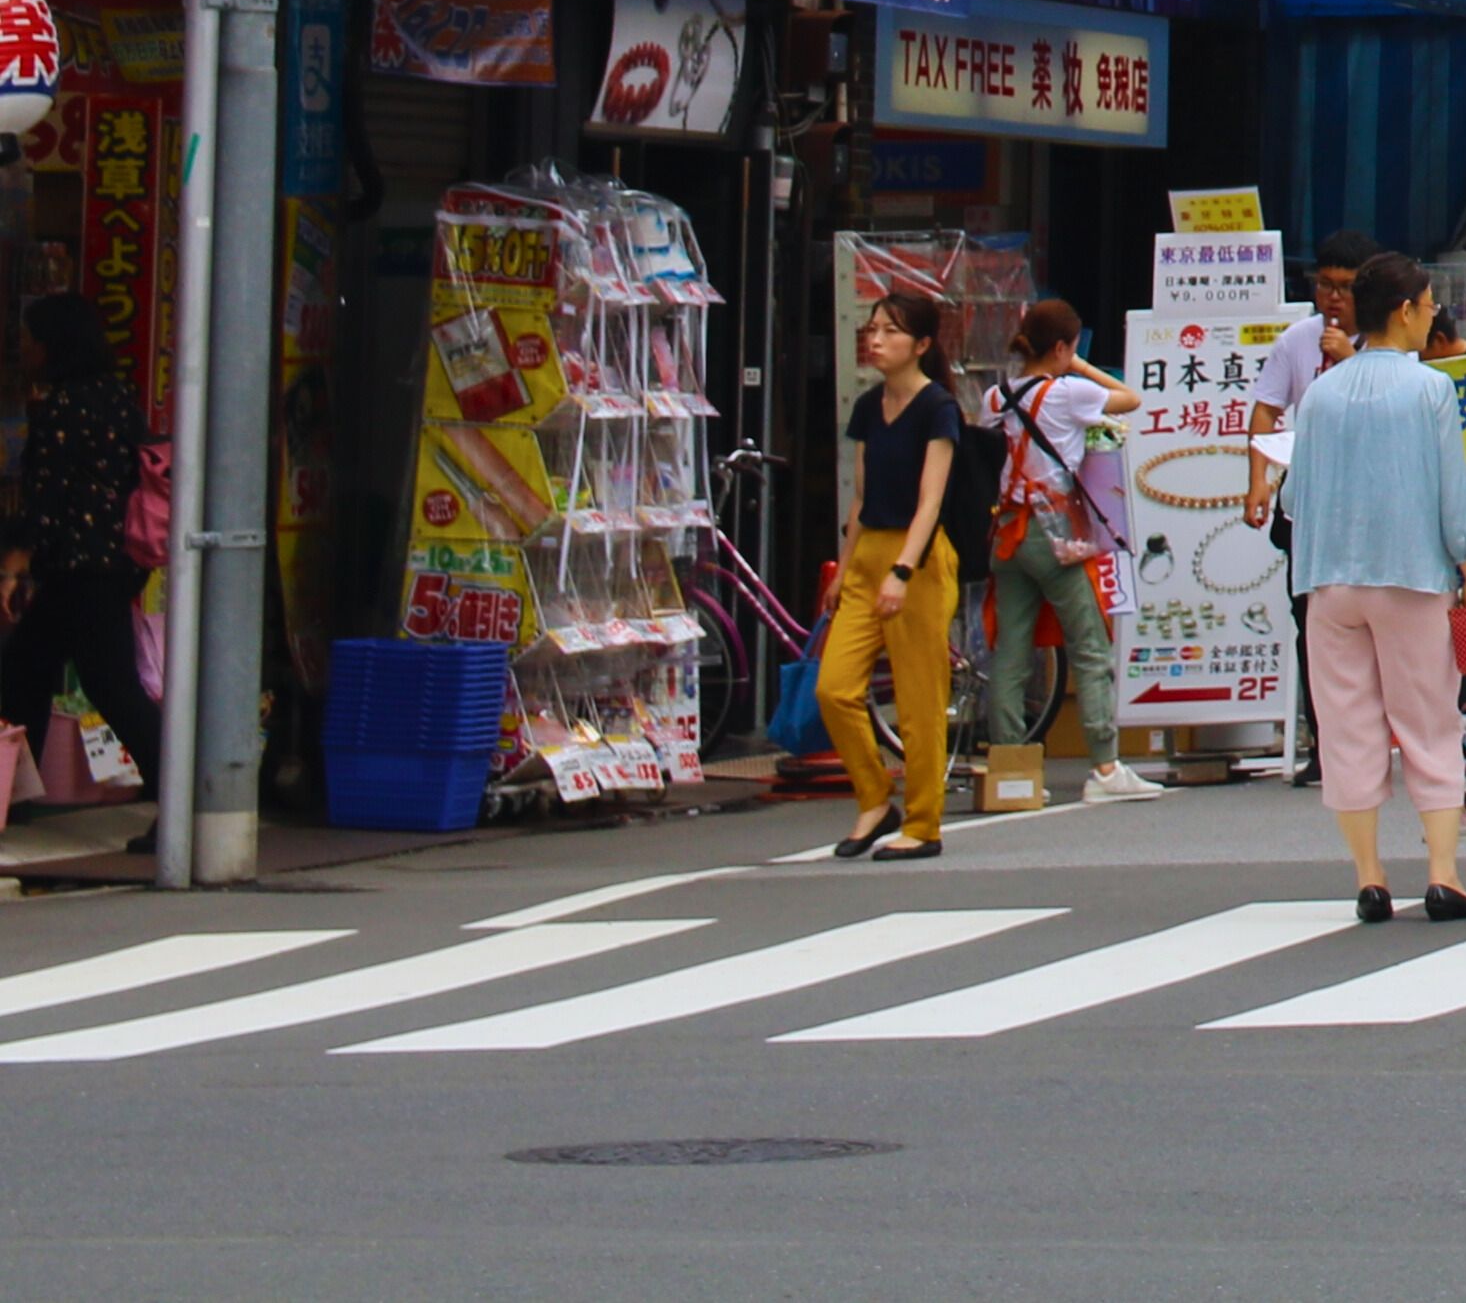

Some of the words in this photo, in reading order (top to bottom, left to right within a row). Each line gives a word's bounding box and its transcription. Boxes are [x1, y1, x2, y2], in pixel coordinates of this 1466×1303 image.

[899, 29, 949, 90] TAX
[954, 37, 1016, 98] FREE
[1237, 676, 1280, 701] 2F
